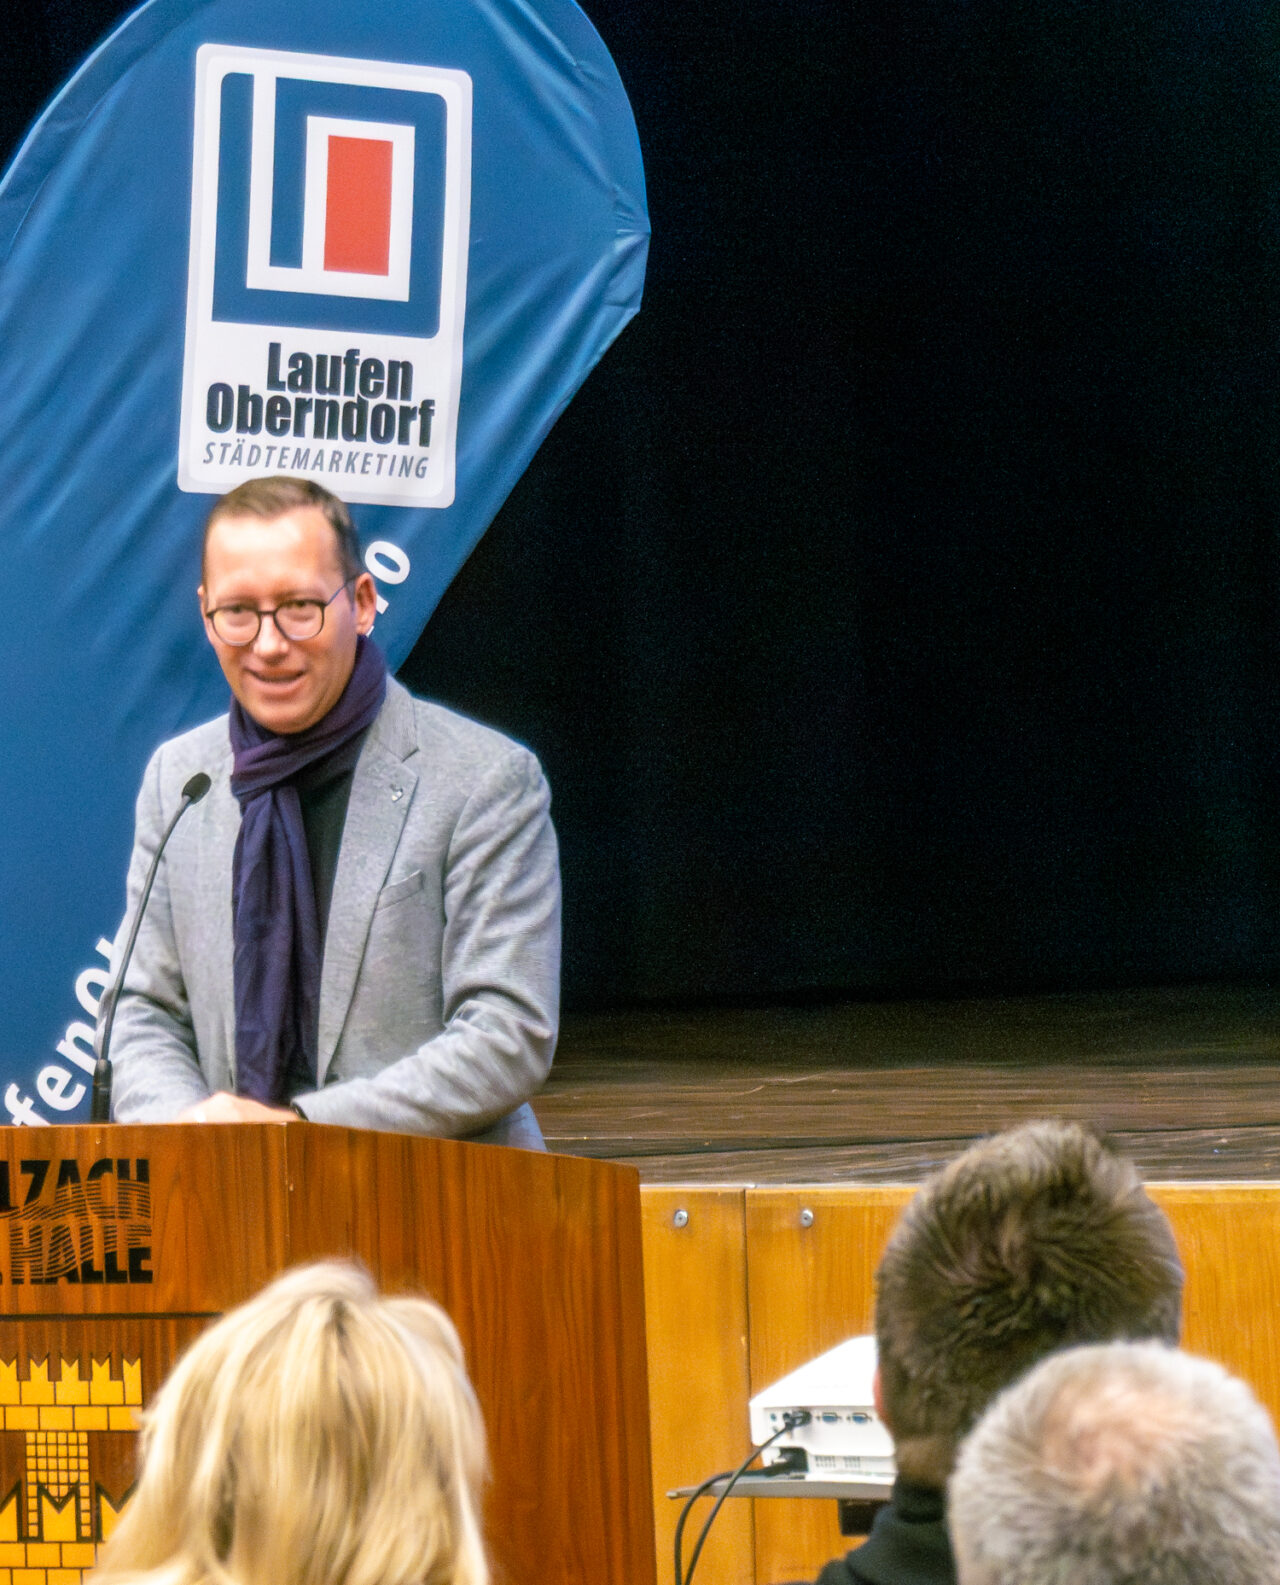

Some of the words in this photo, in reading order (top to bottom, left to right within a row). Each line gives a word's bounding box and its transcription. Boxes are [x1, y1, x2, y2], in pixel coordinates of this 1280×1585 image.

[267, 342, 413, 402] Laufen
[207, 383, 435, 447] Oberndorf
[203, 439, 428, 479] STÄDTEMARKETING
[10, 1224, 153, 1284] HALLE
